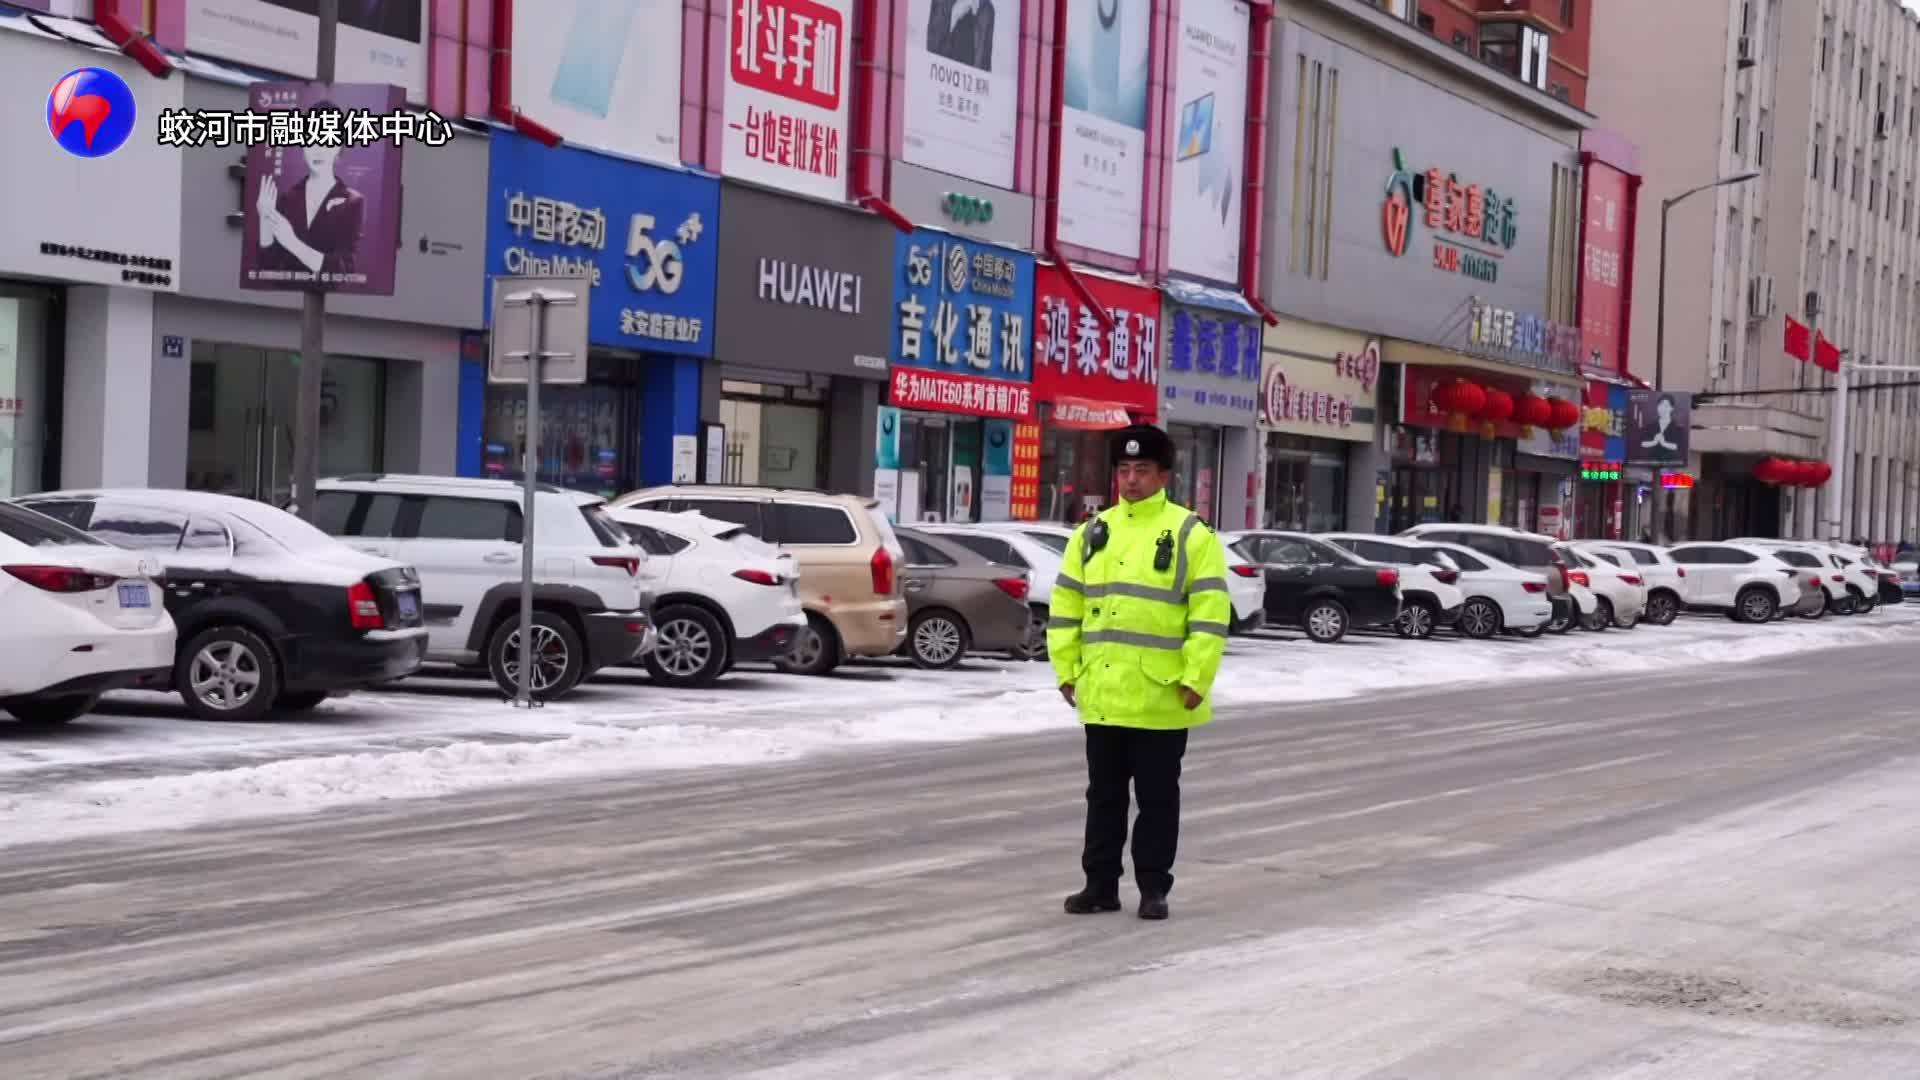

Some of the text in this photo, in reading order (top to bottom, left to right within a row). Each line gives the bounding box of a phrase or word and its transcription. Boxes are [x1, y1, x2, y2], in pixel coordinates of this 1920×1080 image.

[736, 0, 838, 96] 北斗手机
[930, 62, 960, 88] nova
[962, 72, 973, 92] 12
[728, 105, 838, 179] 一台也是批发价
[506, 191, 606, 250] 中国移动
[504, 245, 551, 278] China
[551, 253, 601, 287] Mobile
[758, 257, 861, 314] HUAWEI
[972, 253, 1016, 282] 中国移动
[900, 293, 1024, 374] 吉化通讯
[1036, 295, 1158, 386] 鸿泰通讯
[895, 371, 1031, 415] 华为MATE60系列首销门店
